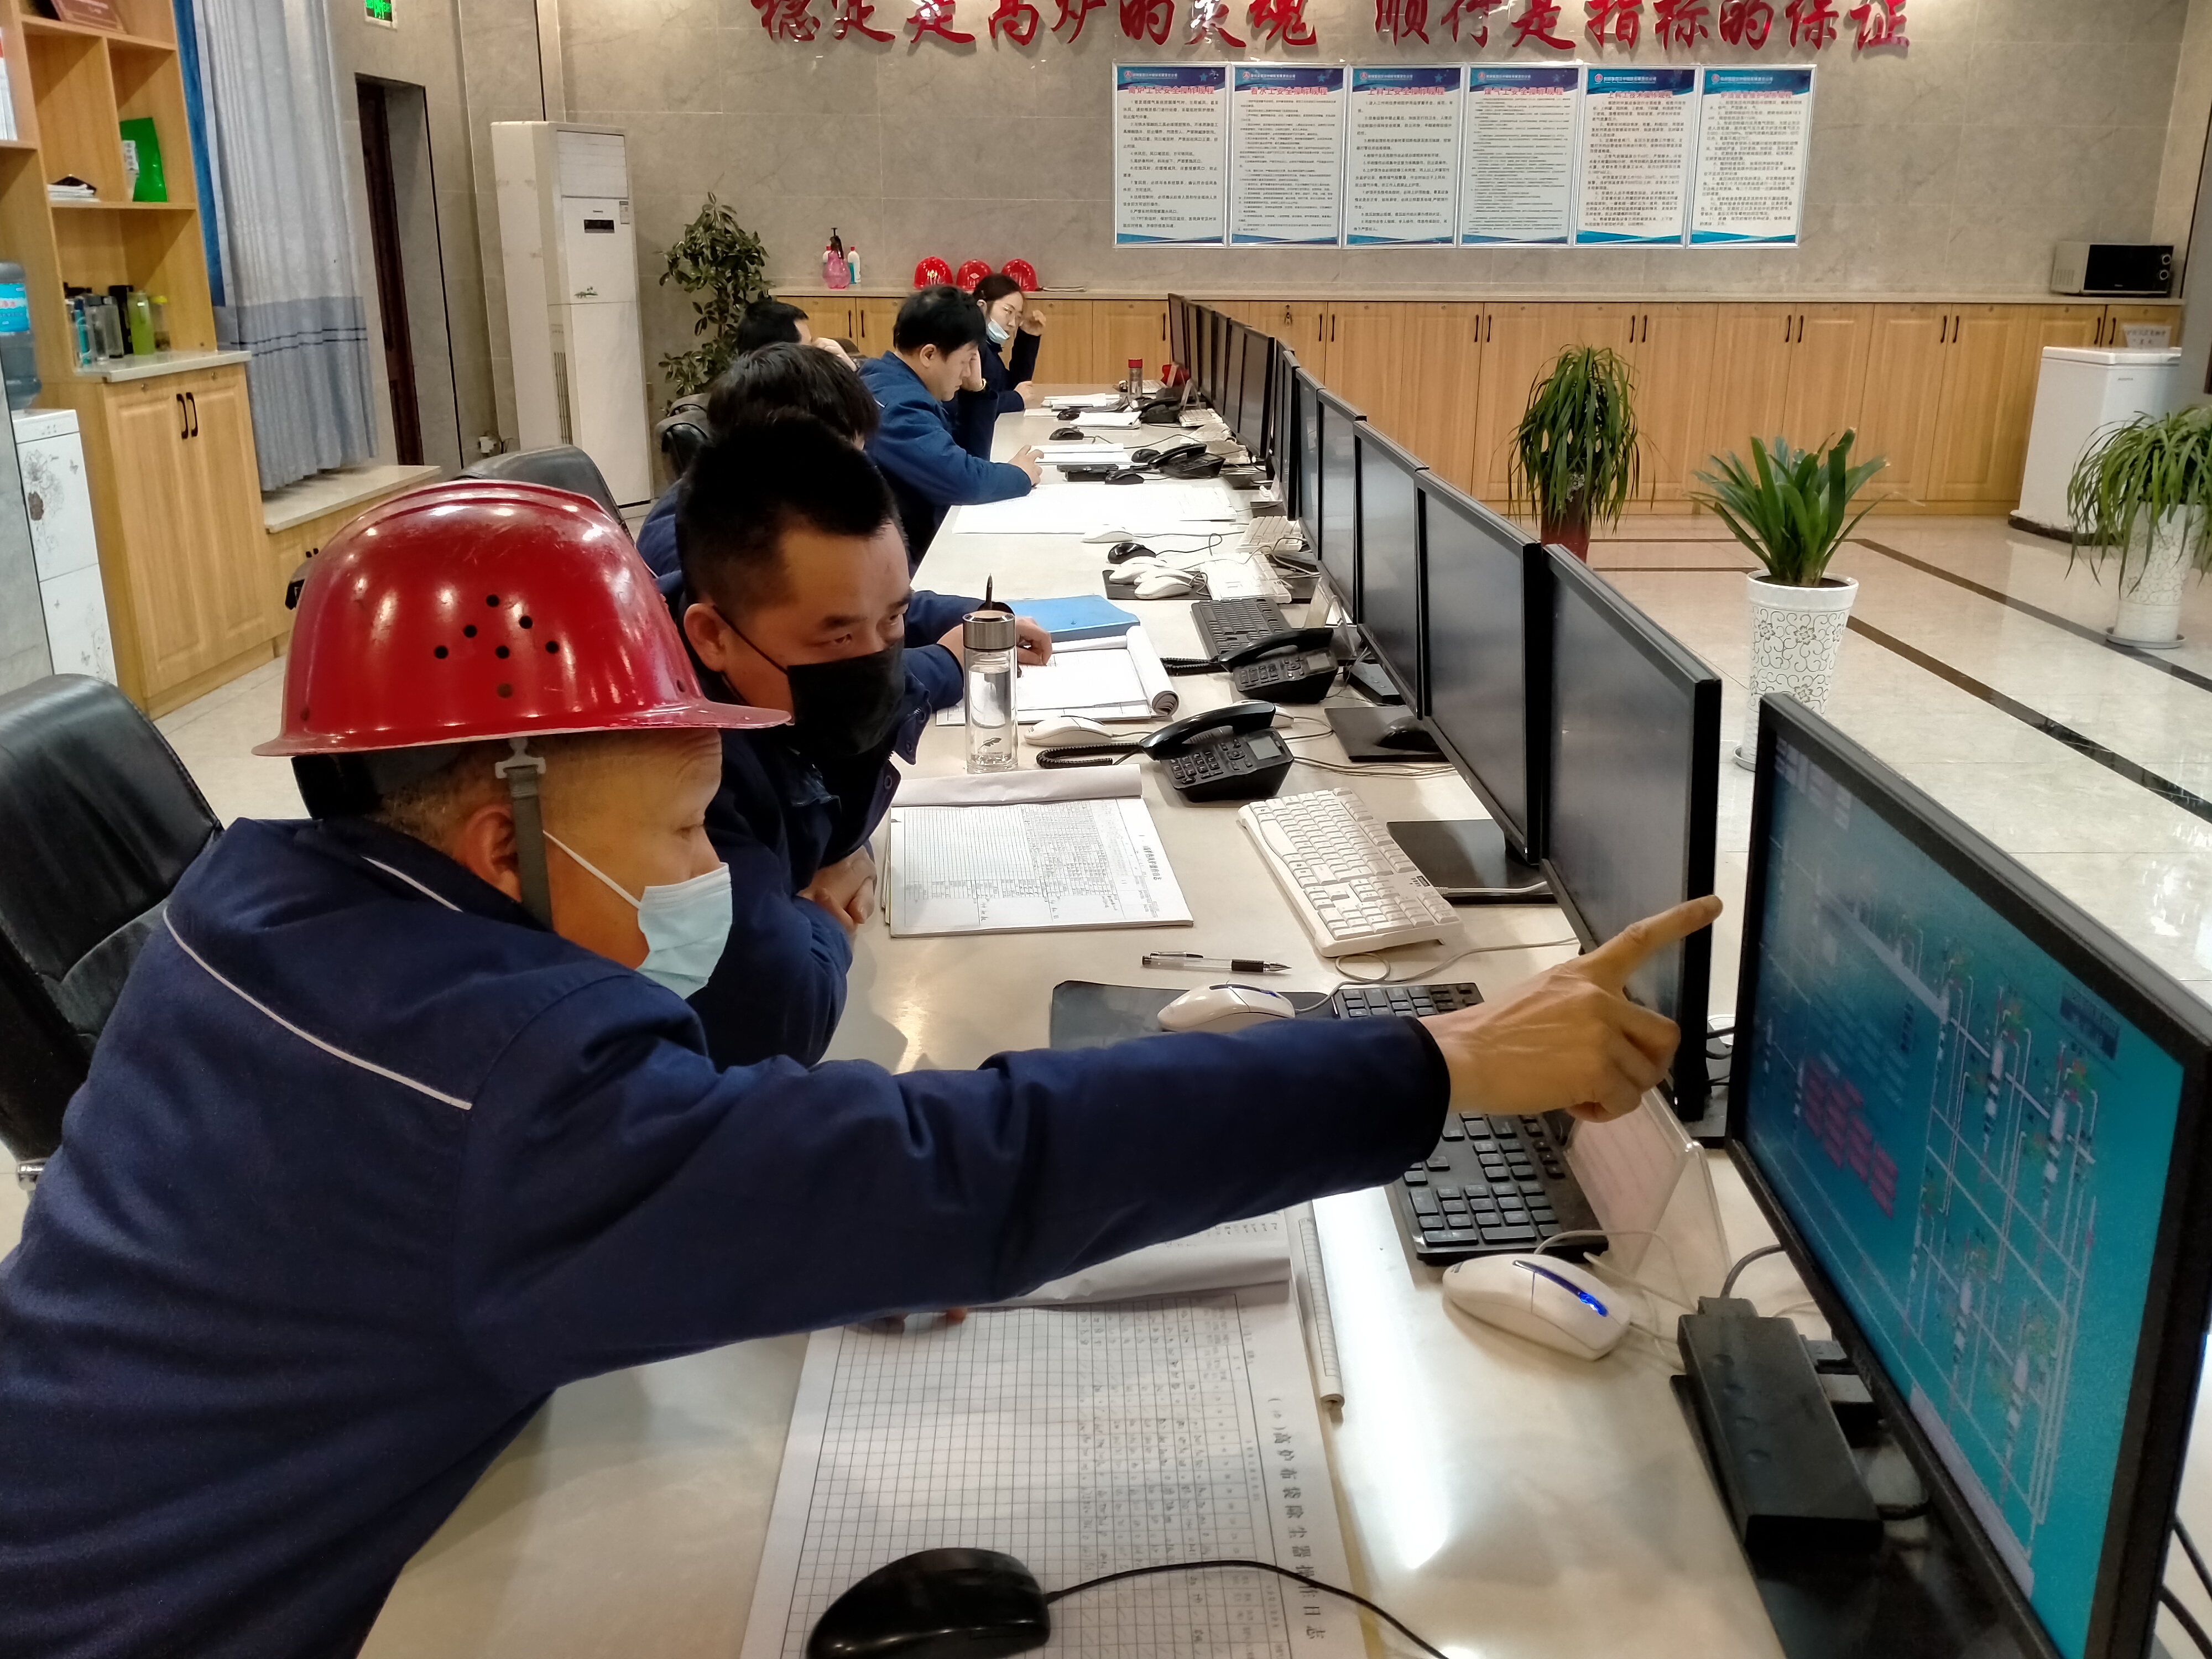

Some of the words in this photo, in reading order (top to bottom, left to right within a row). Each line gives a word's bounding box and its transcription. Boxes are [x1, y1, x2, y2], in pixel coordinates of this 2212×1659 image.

[1128, 86, 1215, 95] 高炉工长安全操作规程
[1250, 87, 1328, 95] 看水工安全操作规程
[1367, 87, 1445, 96] 上料工安全操作规程
[1484, 87, 1564, 96] 煤气工安全操作规程
